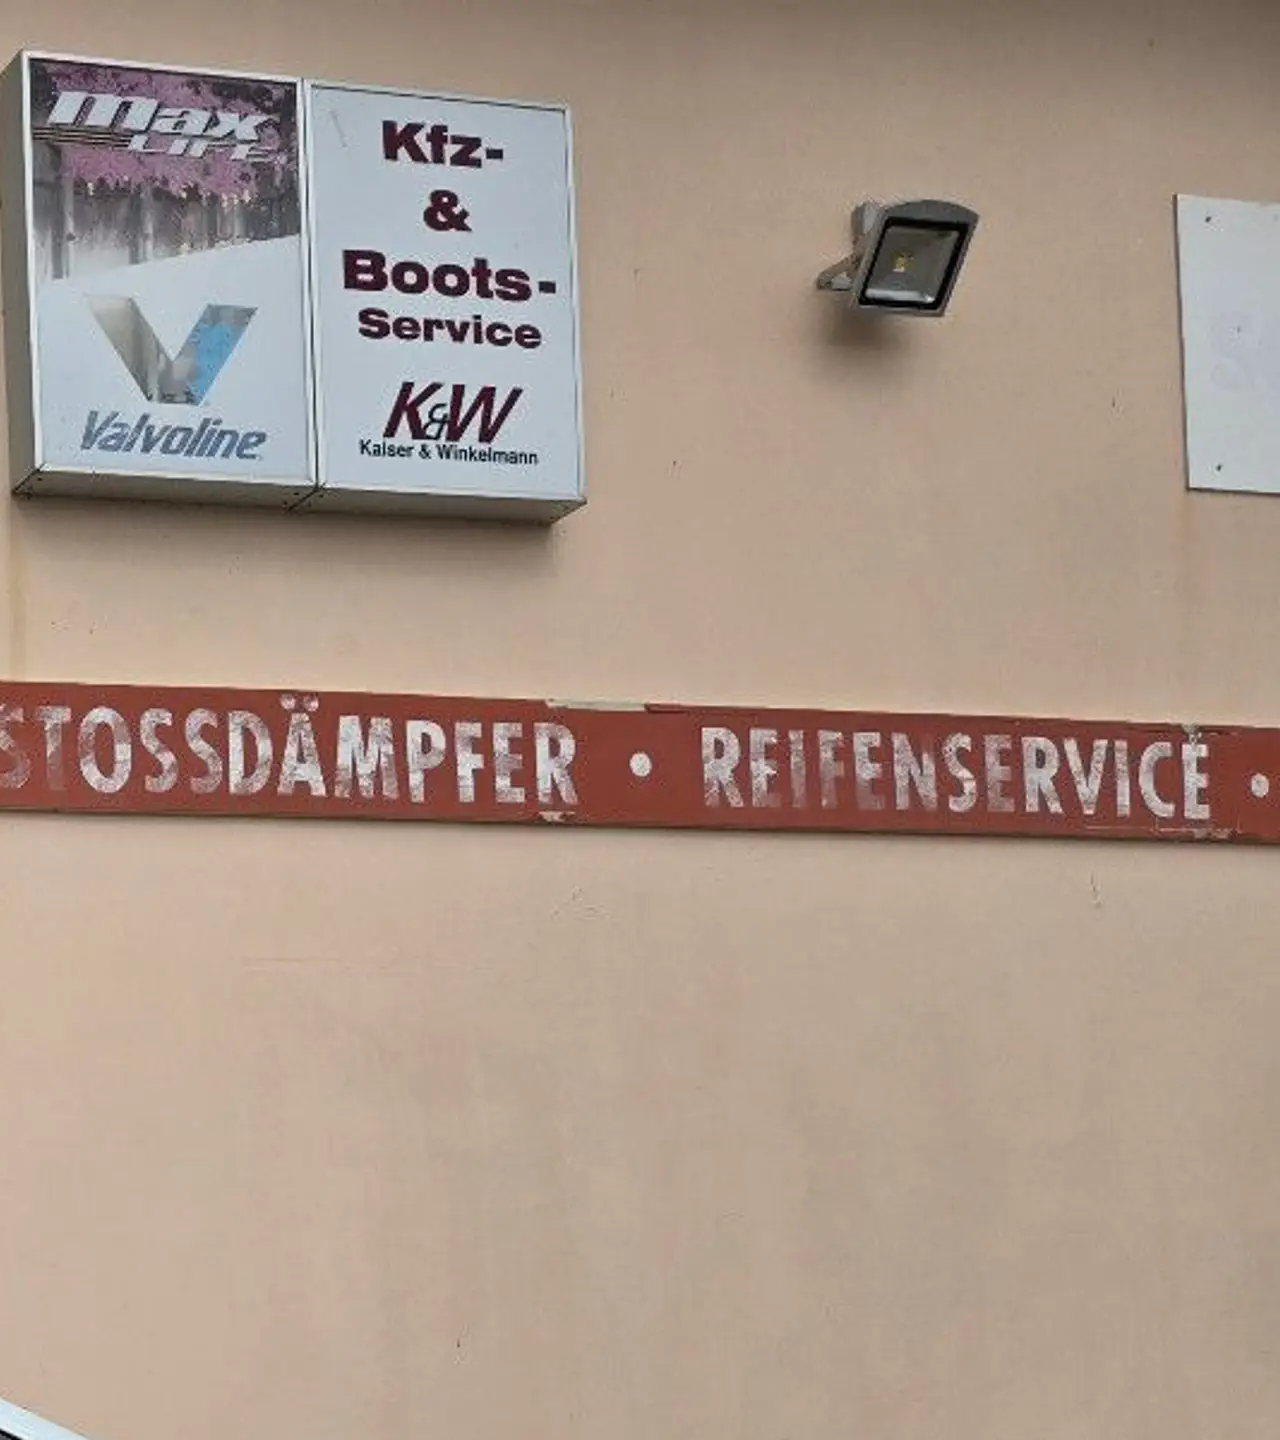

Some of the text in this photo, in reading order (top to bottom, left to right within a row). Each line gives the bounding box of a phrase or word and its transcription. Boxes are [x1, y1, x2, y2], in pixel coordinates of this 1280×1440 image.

[382, 120, 504, 168] Kfz-
[423, 190, 472, 232] &
[343, 249, 557, 301] Boots-
[358, 307, 542, 349] Service
[80, 410, 268, 460] Valvoline
[383, 381, 523, 443] K&W
[360, 438, 539, 466] Kaiser & Winkelmann
[701, 726, 1211, 820] REIFENSERVICE
